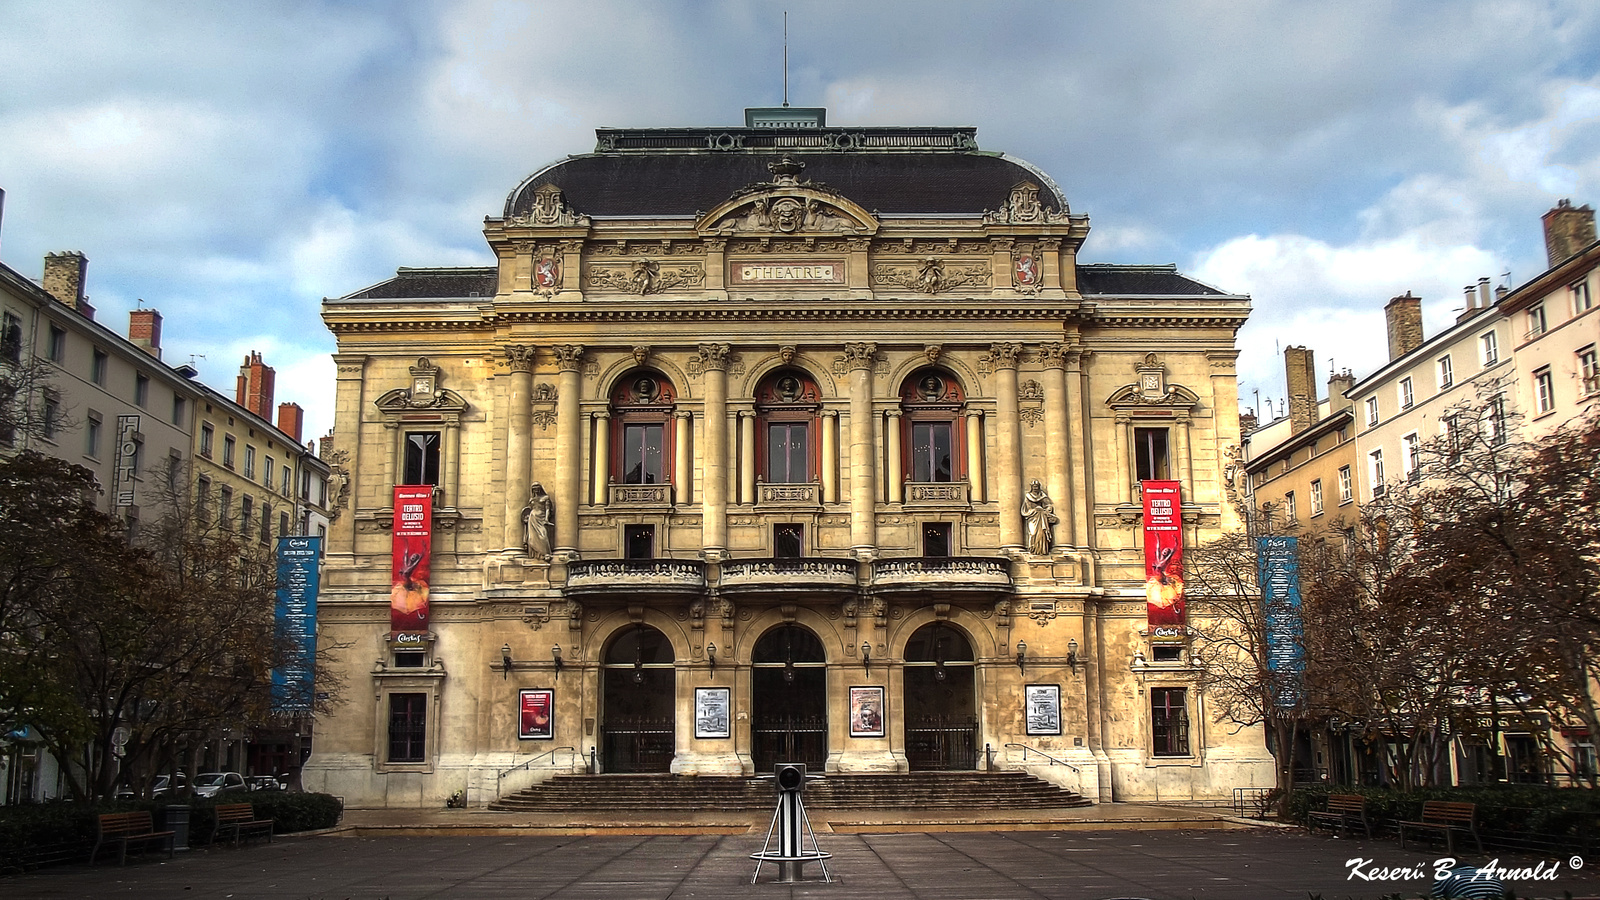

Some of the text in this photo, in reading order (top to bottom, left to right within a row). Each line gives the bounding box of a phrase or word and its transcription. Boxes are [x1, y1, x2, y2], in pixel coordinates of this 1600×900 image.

[752, 267, 823, 279] THEATRE
[117, 415, 140, 507] HOTE
[403, 504, 423, 512] TEATRO
